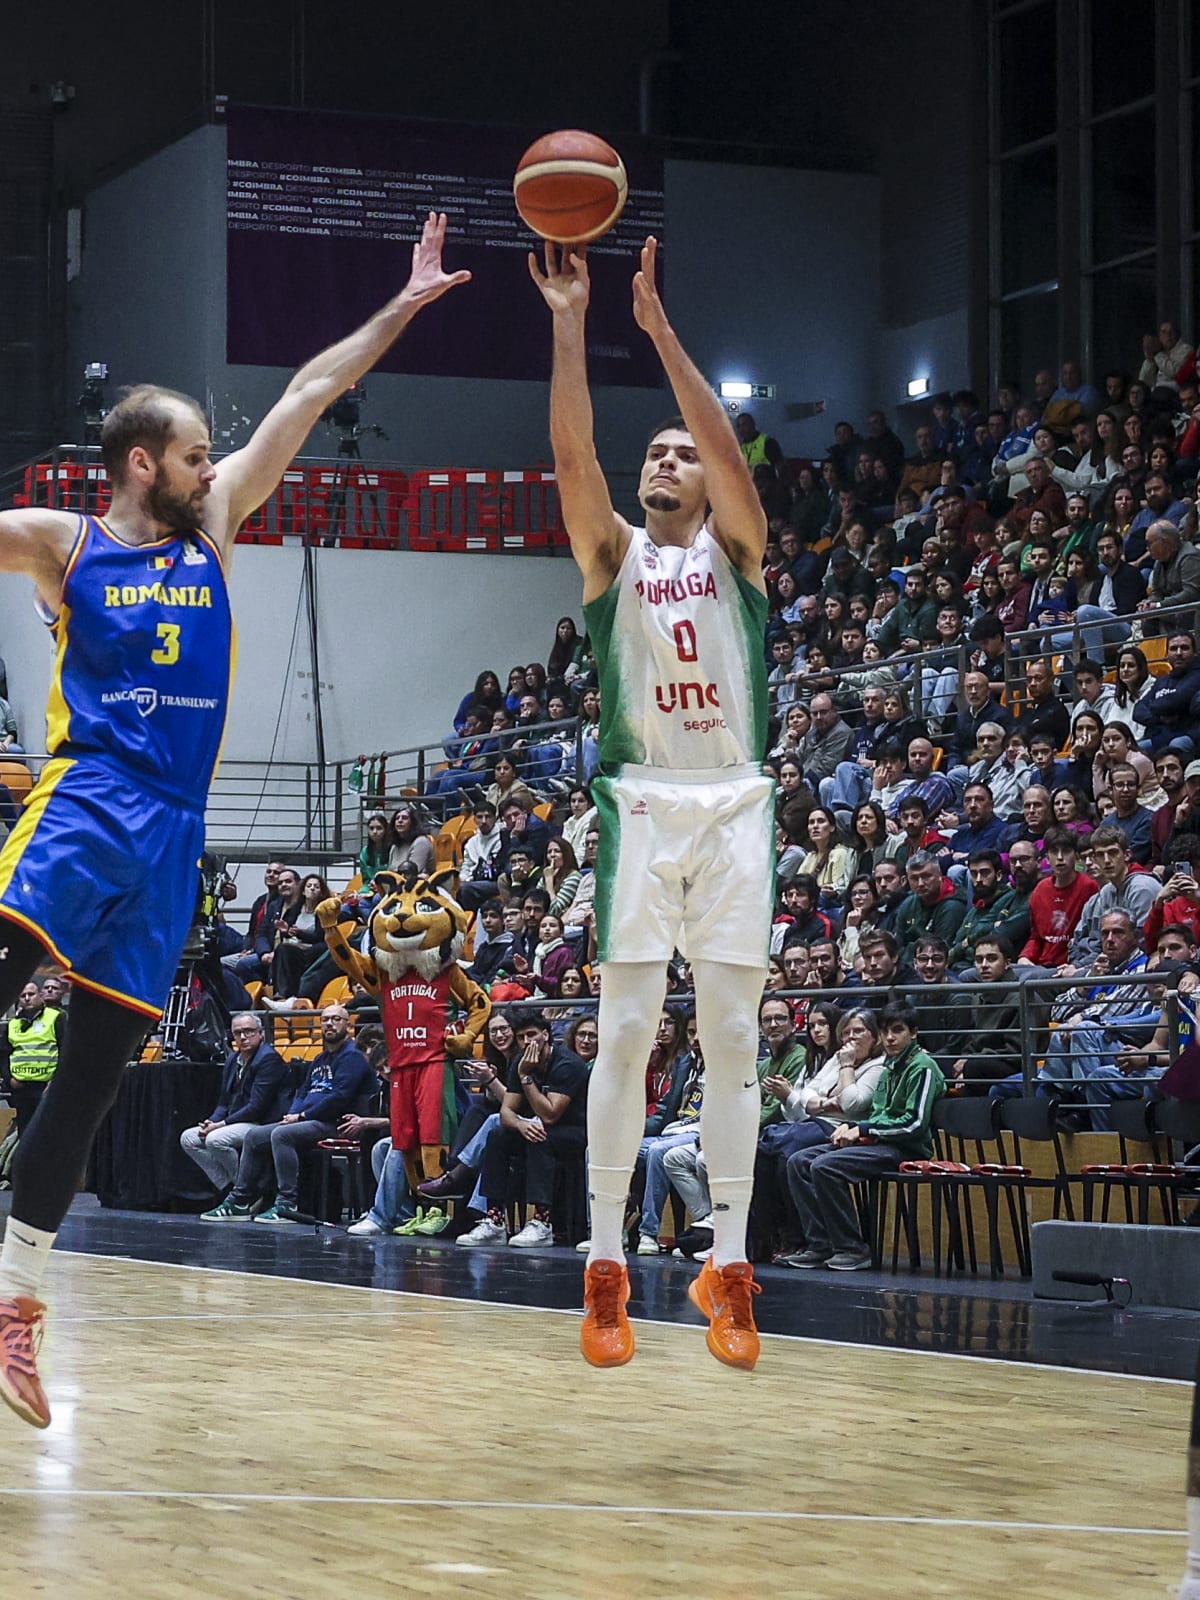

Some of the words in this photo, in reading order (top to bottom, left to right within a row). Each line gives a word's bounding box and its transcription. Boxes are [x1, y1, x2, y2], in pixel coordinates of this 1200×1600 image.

[261, 162, 311, 172] DESPORTO
[312, 166, 364, 176] #COIMBRA
[415, 173, 465, 184] #COIMBRA
[280, 174, 331, 184] #COIMBRA
[383, 181, 433, 191] #COIMBRA
[232, 181, 283, 191] #COIMBRA
[337, 188, 387, 198] #COIMBRA
[440, 196, 489, 206] #COIMBRA
[312, 197, 363, 207] #COIMBRA
[262, 204, 313, 214] #COIMBRA
[366, 211, 416, 221] #COIMBRA
[469, 218, 518, 228] #COIMBRA
[312, 218, 363, 228] #COIMBRA
[280, 225, 331, 235] #COIMBRA
[485, 240, 535, 250] #COIMBRA
[104, 582, 213, 608] ROMANIA
[150, 622, 182, 666] 3
[672, 619, 699, 663] 0
[136, 693, 152, 704] BT
[390, 984, 438, 1002] PORTUGAL
[407, 1002, 414, 1021] 1
[396, 1027, 428, 1040] una
